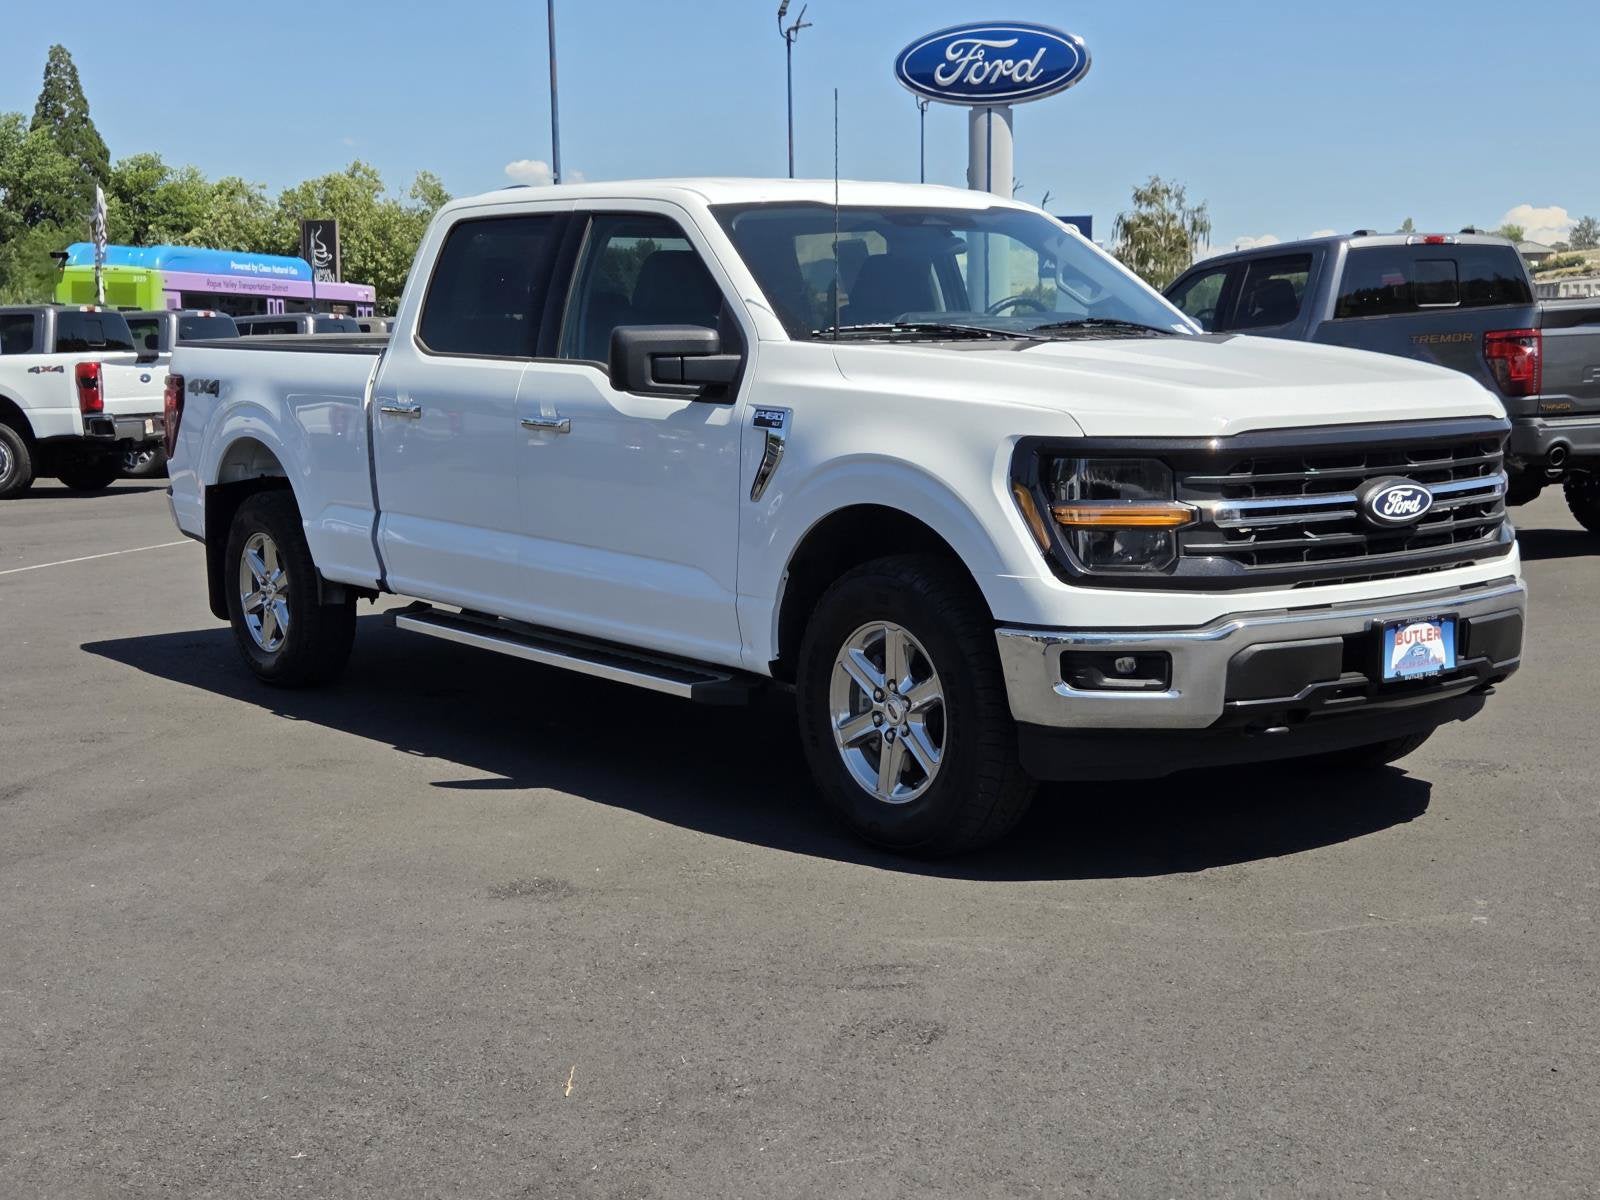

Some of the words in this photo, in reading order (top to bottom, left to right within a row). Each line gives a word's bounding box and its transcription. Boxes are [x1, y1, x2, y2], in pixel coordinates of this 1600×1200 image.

[934, 37, 1047, 87] Ford
[230, 261, 251, 271] Powered
[251, 263, 258, 273] by
[258, 263, 271, 272] Clean
[272, 264, 288, 274] Natural
[207, 278, 222, 289] Rogue
[223, 280, 238, 291] Valley
[239, 281, 271, 292] Transportation
[271, 284, 288, 292] District
[1411, 333, 1474, 345] TREMOR
[1384, 489, 1422, 515] Ford
[1395, 626, 1442, 646] BUTLER
